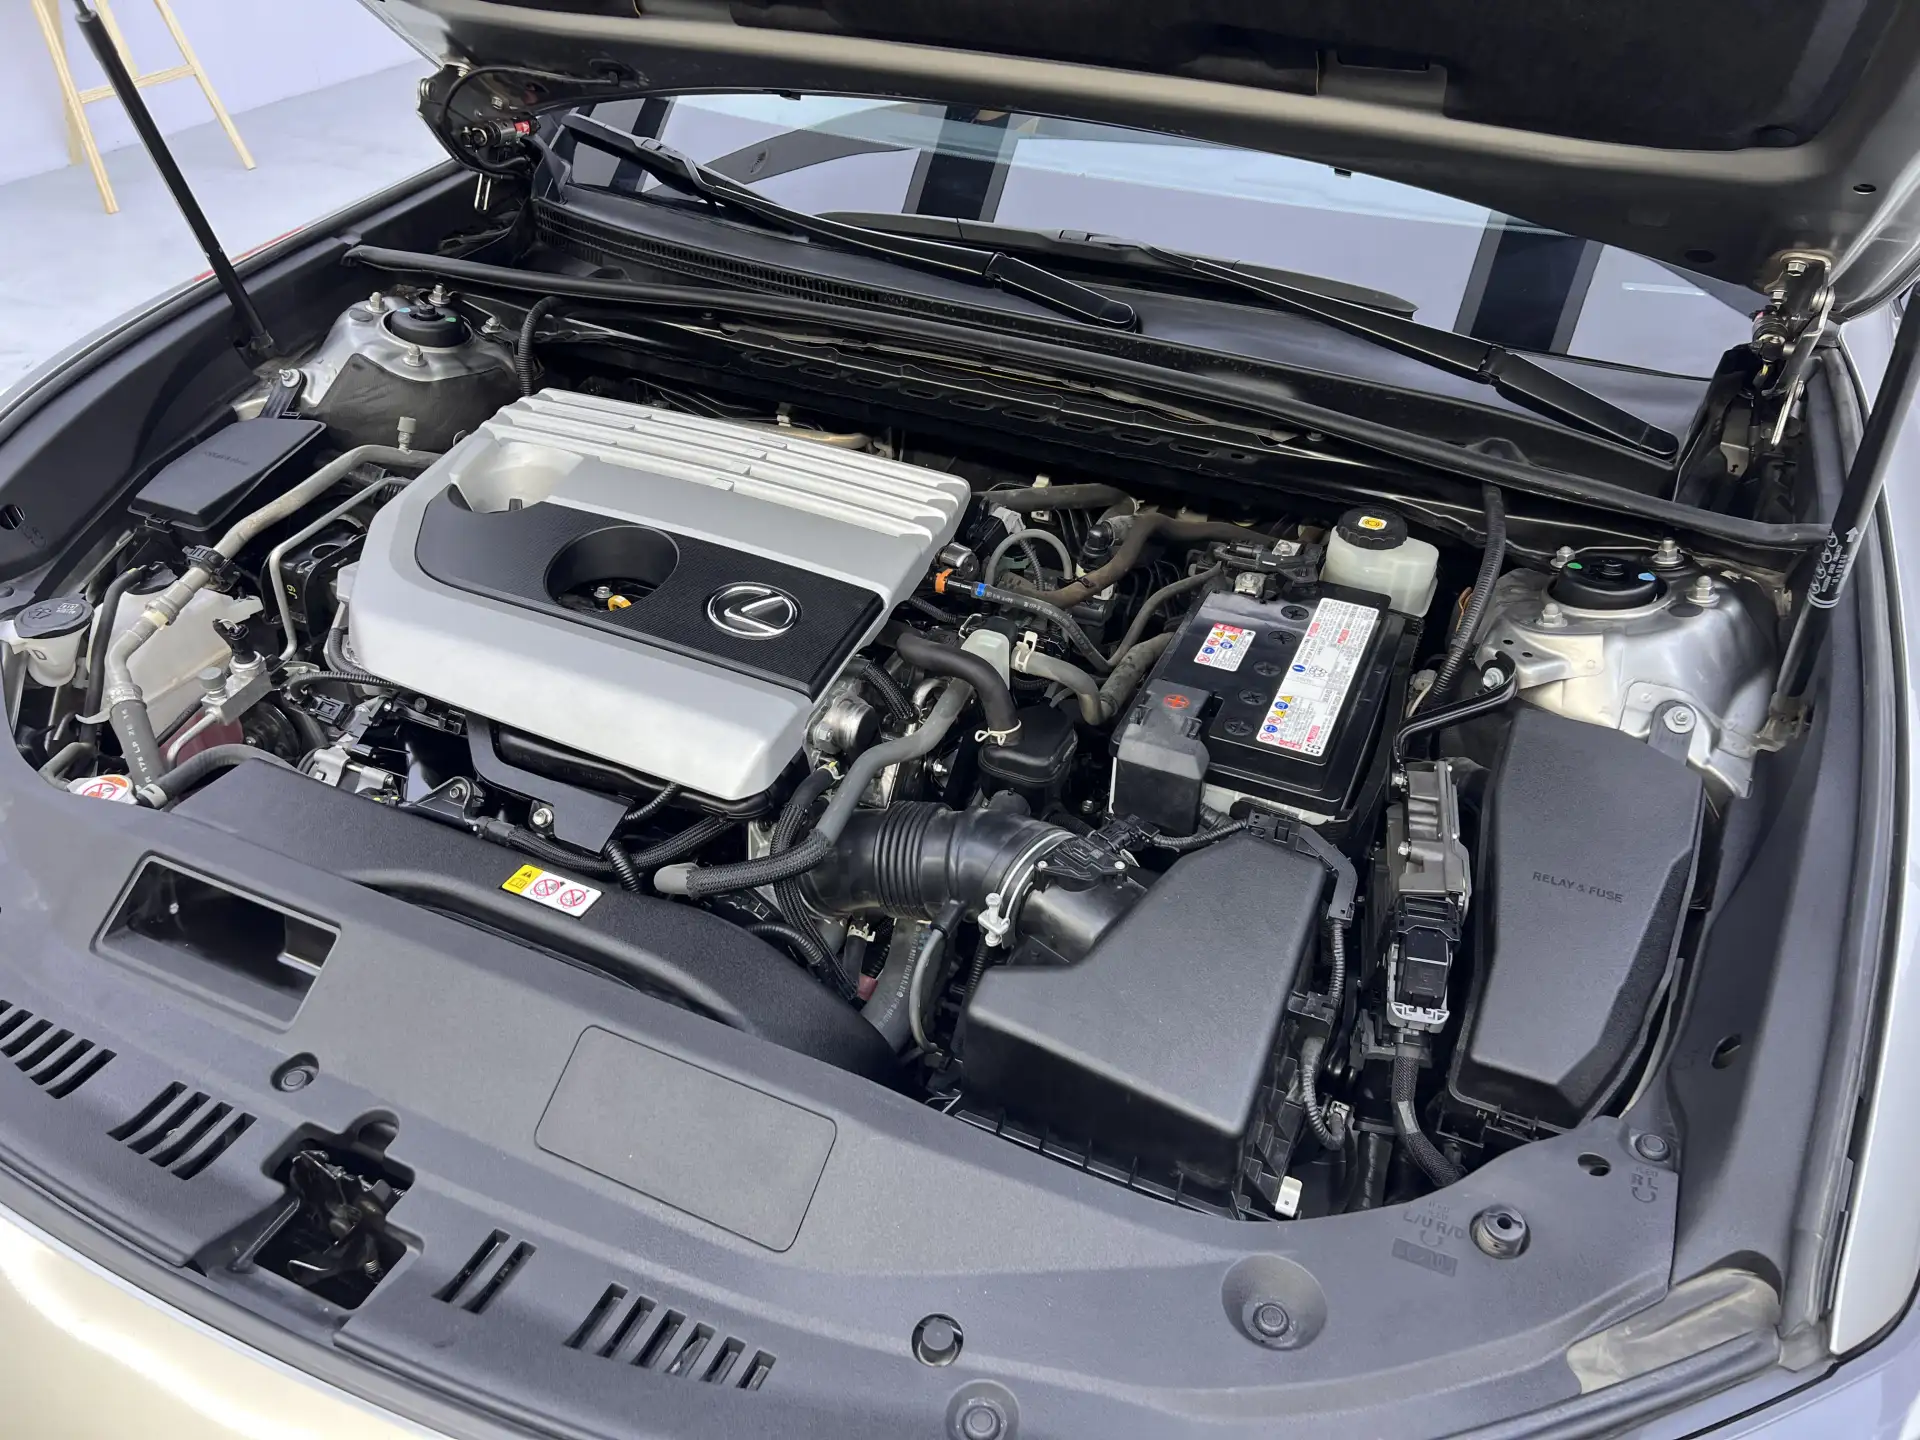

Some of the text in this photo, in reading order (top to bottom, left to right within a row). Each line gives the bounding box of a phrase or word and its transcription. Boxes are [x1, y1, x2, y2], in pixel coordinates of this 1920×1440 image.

[1532, 871, 1624, 903] RELAY & FUSE
